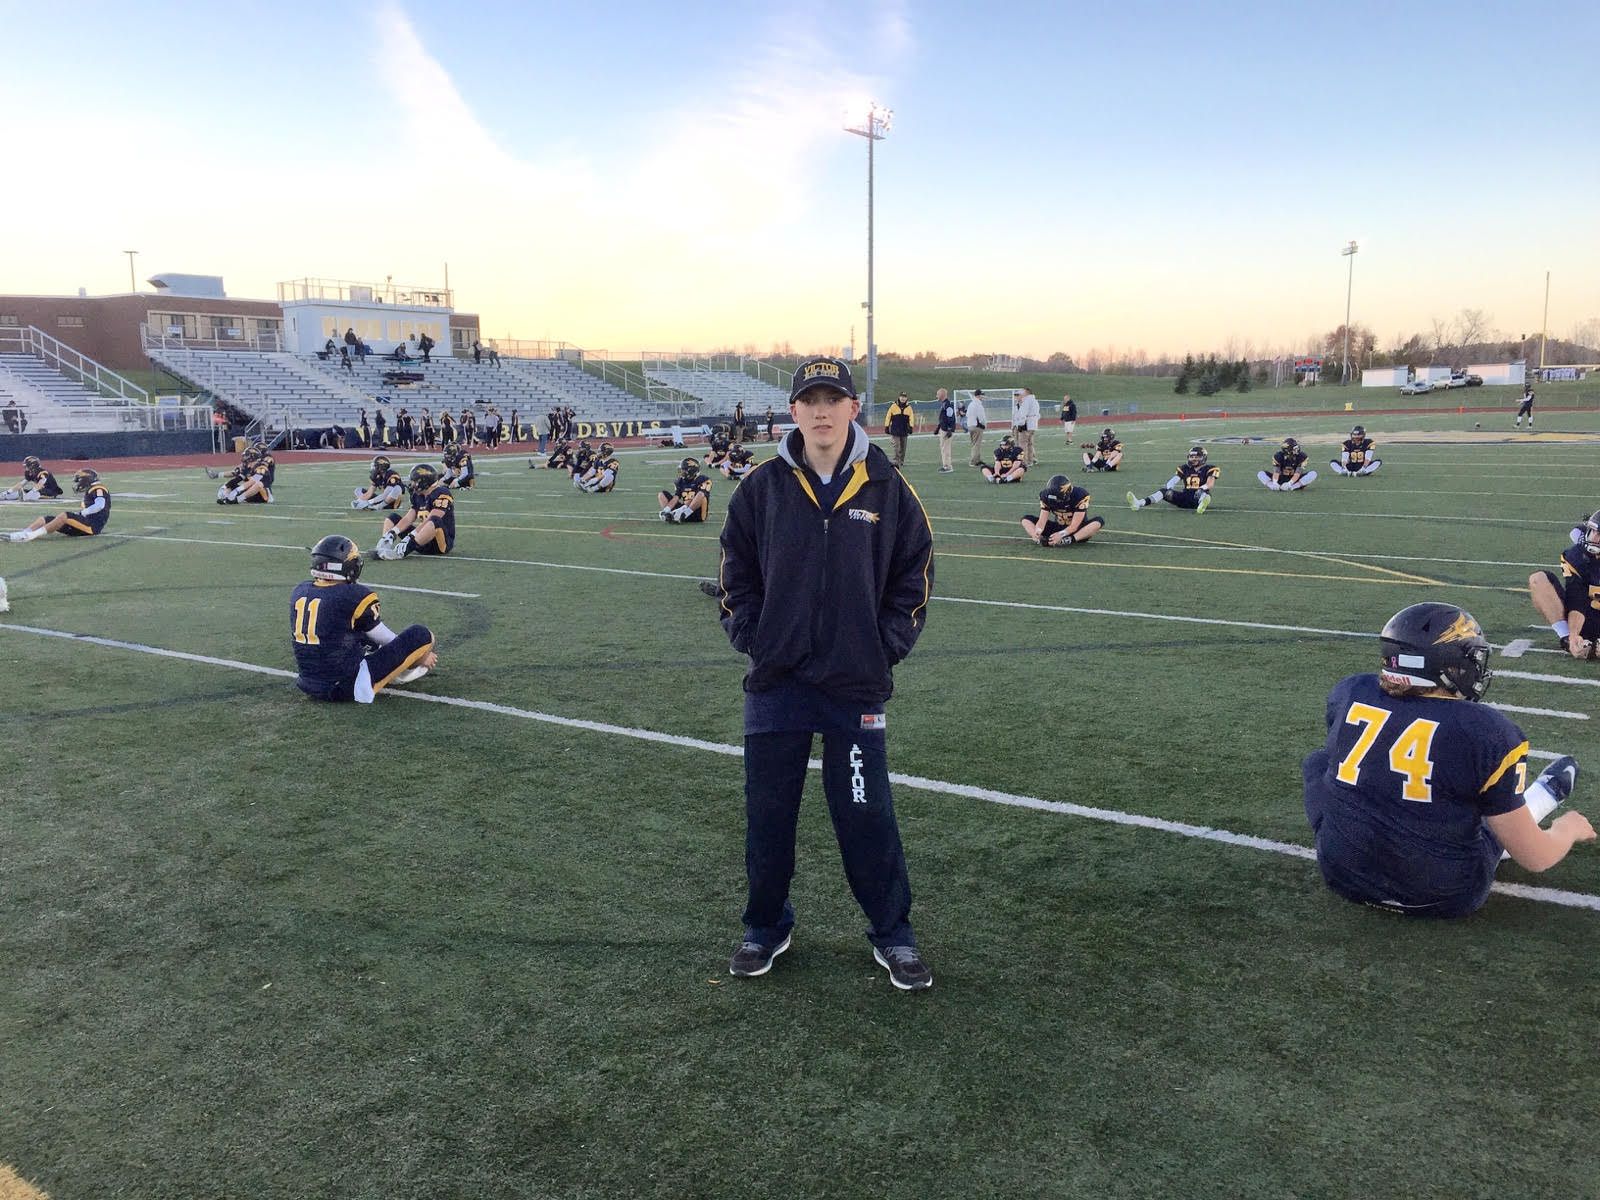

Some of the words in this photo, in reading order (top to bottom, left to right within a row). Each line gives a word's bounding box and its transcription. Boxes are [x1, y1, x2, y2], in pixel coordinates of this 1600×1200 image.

[804, 363, 839, 374] VICTOR
[577, 420, 661, 438] DEVILS
[294, 596, 321, 645] 11
[1336, 701, 1440, 803] 74
